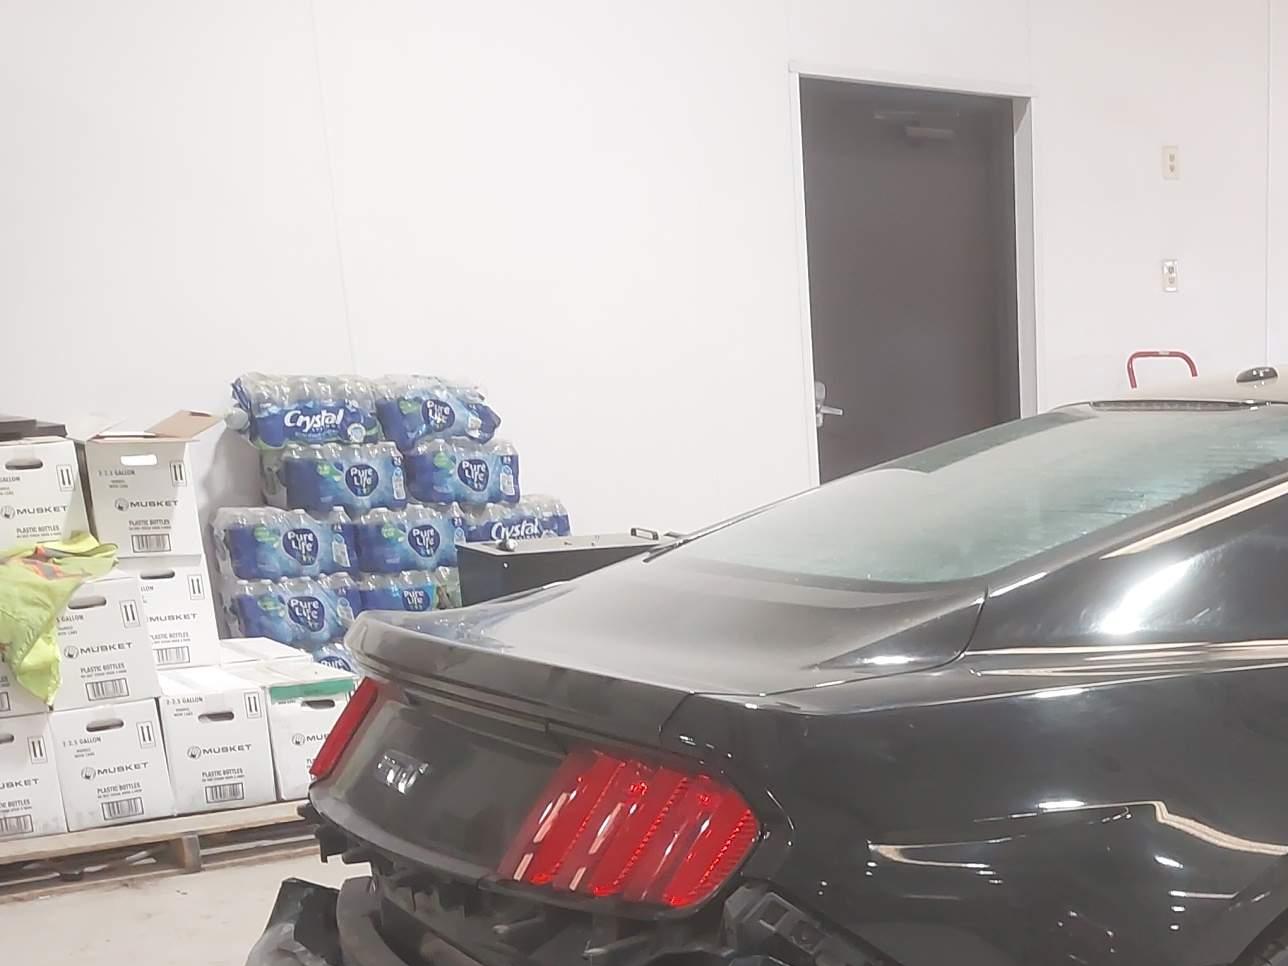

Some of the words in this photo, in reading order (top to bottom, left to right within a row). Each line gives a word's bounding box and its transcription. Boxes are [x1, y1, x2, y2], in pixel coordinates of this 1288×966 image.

[426, 400, 451, 415] Pure
[283, 408, 344, 433] Crystal
[462, 460, 486, 472] Pure
[350, 467, 373, 478] Pure
[464, 470, 484, 483] Life
[353, 475, 373, 488] Life
[16, 505, 68, 515] MUSKET
[130, 500, 178, 508] MUSKET
[39, 525, 60, 533] BOTTLES
[412, 528, 435, 538] Pure
[491, 518, 541, 541] Crystal
[287, 530, 314, 542] Pure
[291, 539, 314, 554] Life
[416, 537, 435, 549] Life
[403, 591, 425, 599] Pure
[290, 599, 319, 610] Pure
[149, 613, 198, 622] MUSKET
[295, 606, 318, 621] Life
[80, 642, 132, 655] MUSKET
[80, 665, 102, 674] PLASTIC
[103, 662, 125, 671] BOTTLES
[203, 744, 252, 755] MUSKET
[97, 761, 149, 775] MUSKET
[97, 785, 118, 794] PLASTIC
[119, 782, 141, 791] BOTTLES
[8, 799, 30, 808] BOTTLES
